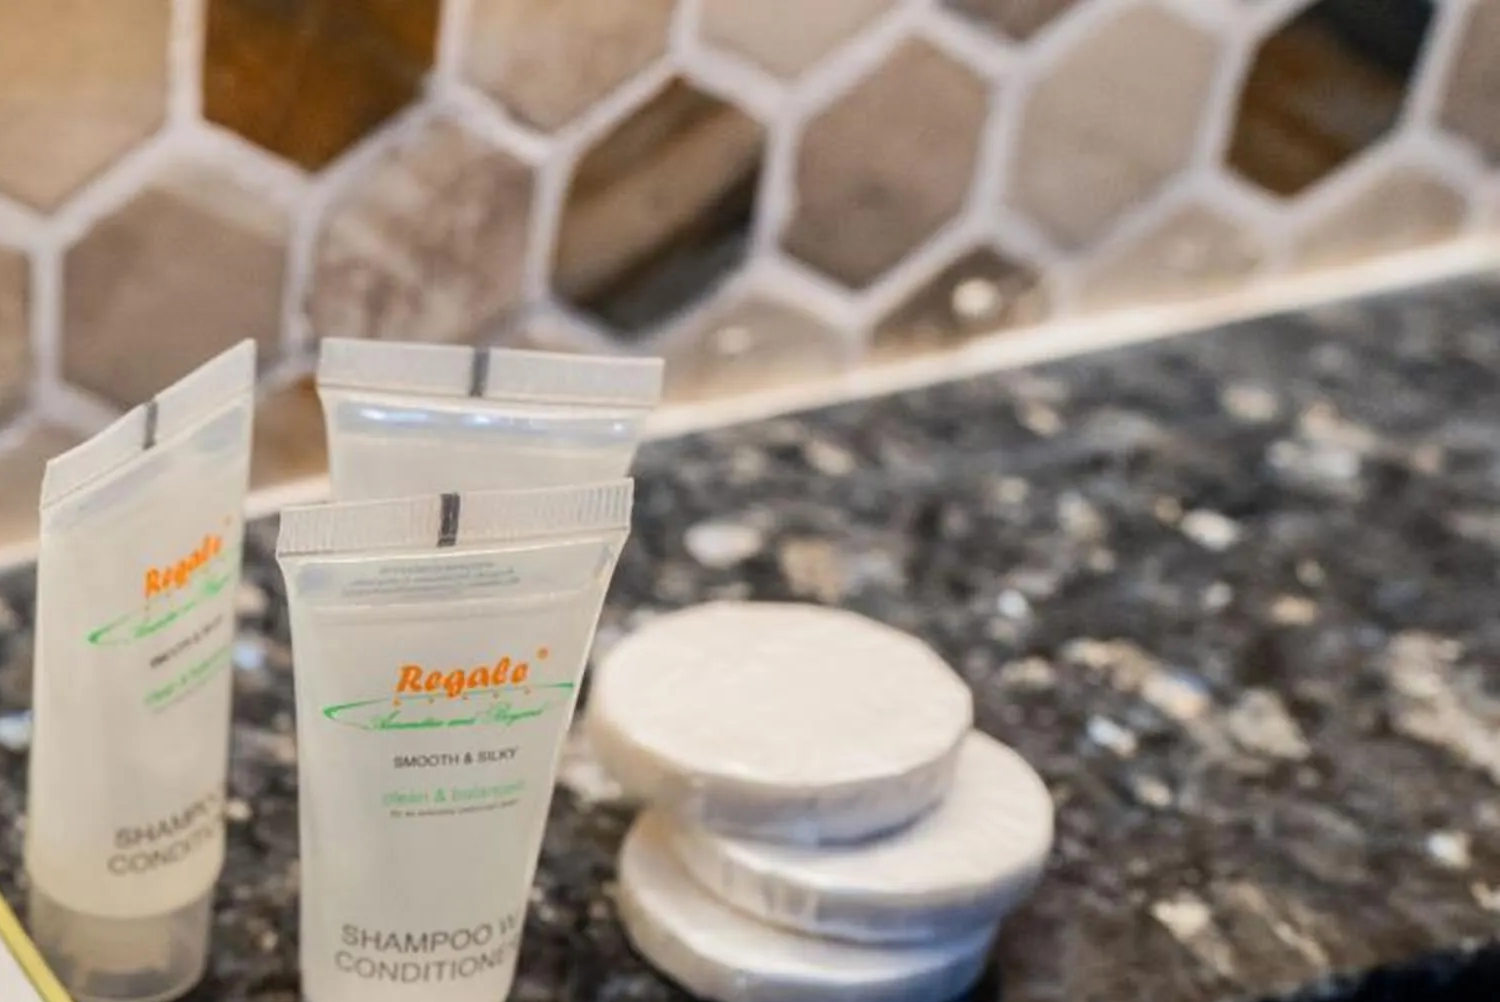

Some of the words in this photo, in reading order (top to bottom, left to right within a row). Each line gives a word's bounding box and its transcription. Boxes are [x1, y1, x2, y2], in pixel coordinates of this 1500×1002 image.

[396, 657, 528, 698] Regale
[393, 754, 459, 769] SMOOTH
[464, 751, 473, 764] &
[477, 748, 517, 763] SILKY
[341, 923, 493, 953] SHAMPOO
